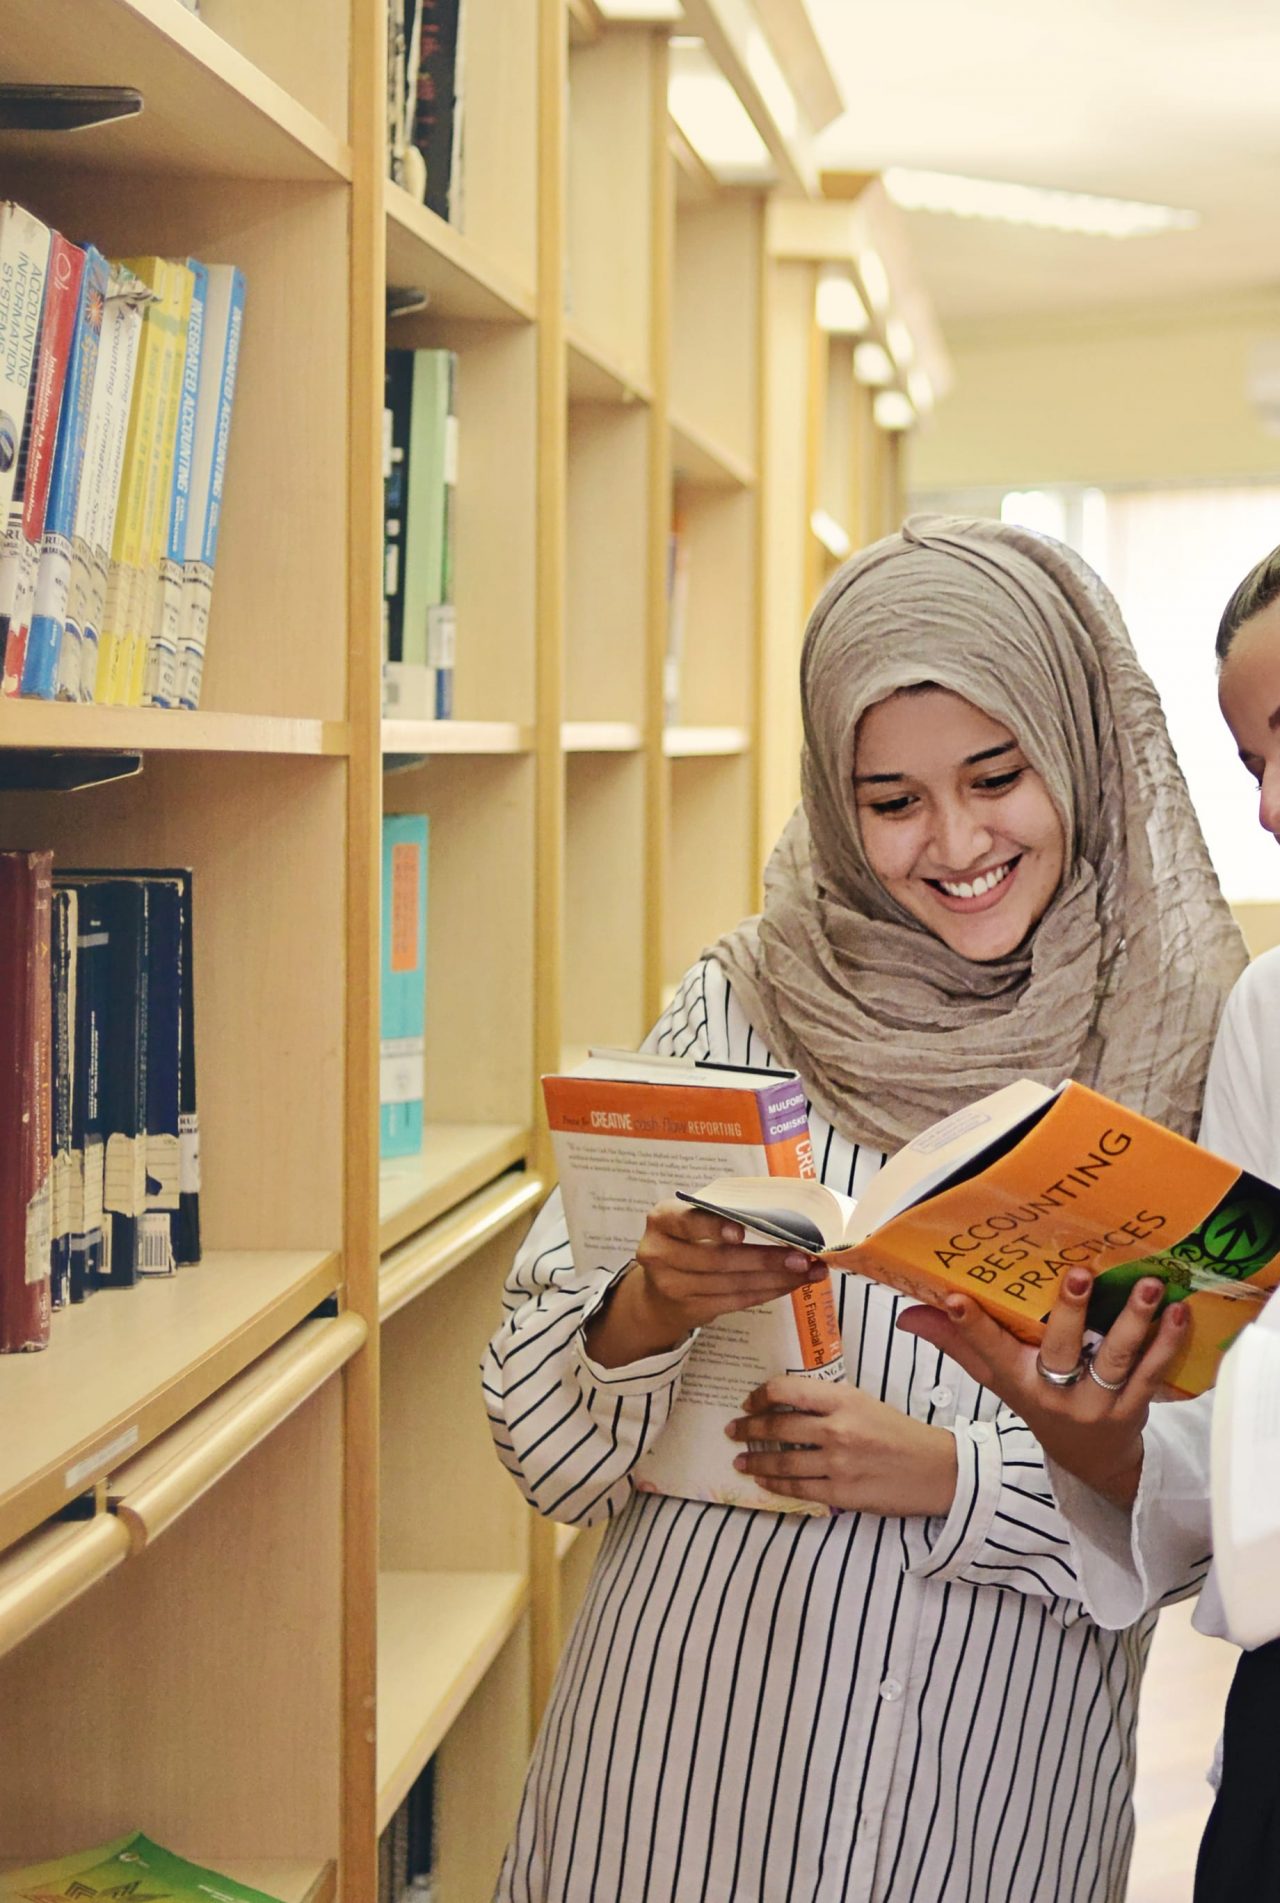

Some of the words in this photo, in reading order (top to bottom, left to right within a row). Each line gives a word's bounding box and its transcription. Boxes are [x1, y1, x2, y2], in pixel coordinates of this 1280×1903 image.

[5, 252, 29, 382] INFORMATION
[17, 264, 42, 389] ACCOUNTING
[184, 299, 203, 399] INTEGRATED
[221, 305, 242, 405] INTEGRATED
[176, 391, 197, 494] ACCOUNTING
[212, 402, 233, 498] ACCOUNTING
[590, 1110, 633, 1130] CREATIVE
[687, 1120, 743, 1137] REPORTING
[768, 1094, 804, 1114] MULFORD
[934, 1128, 1133, 1269] ACCOUNTING
[966, 1233, 1048, 1285] BEST
[1003, 1209, 1166, 1302] PRACTICES
[806, 1301, 822, 1347] Financial
